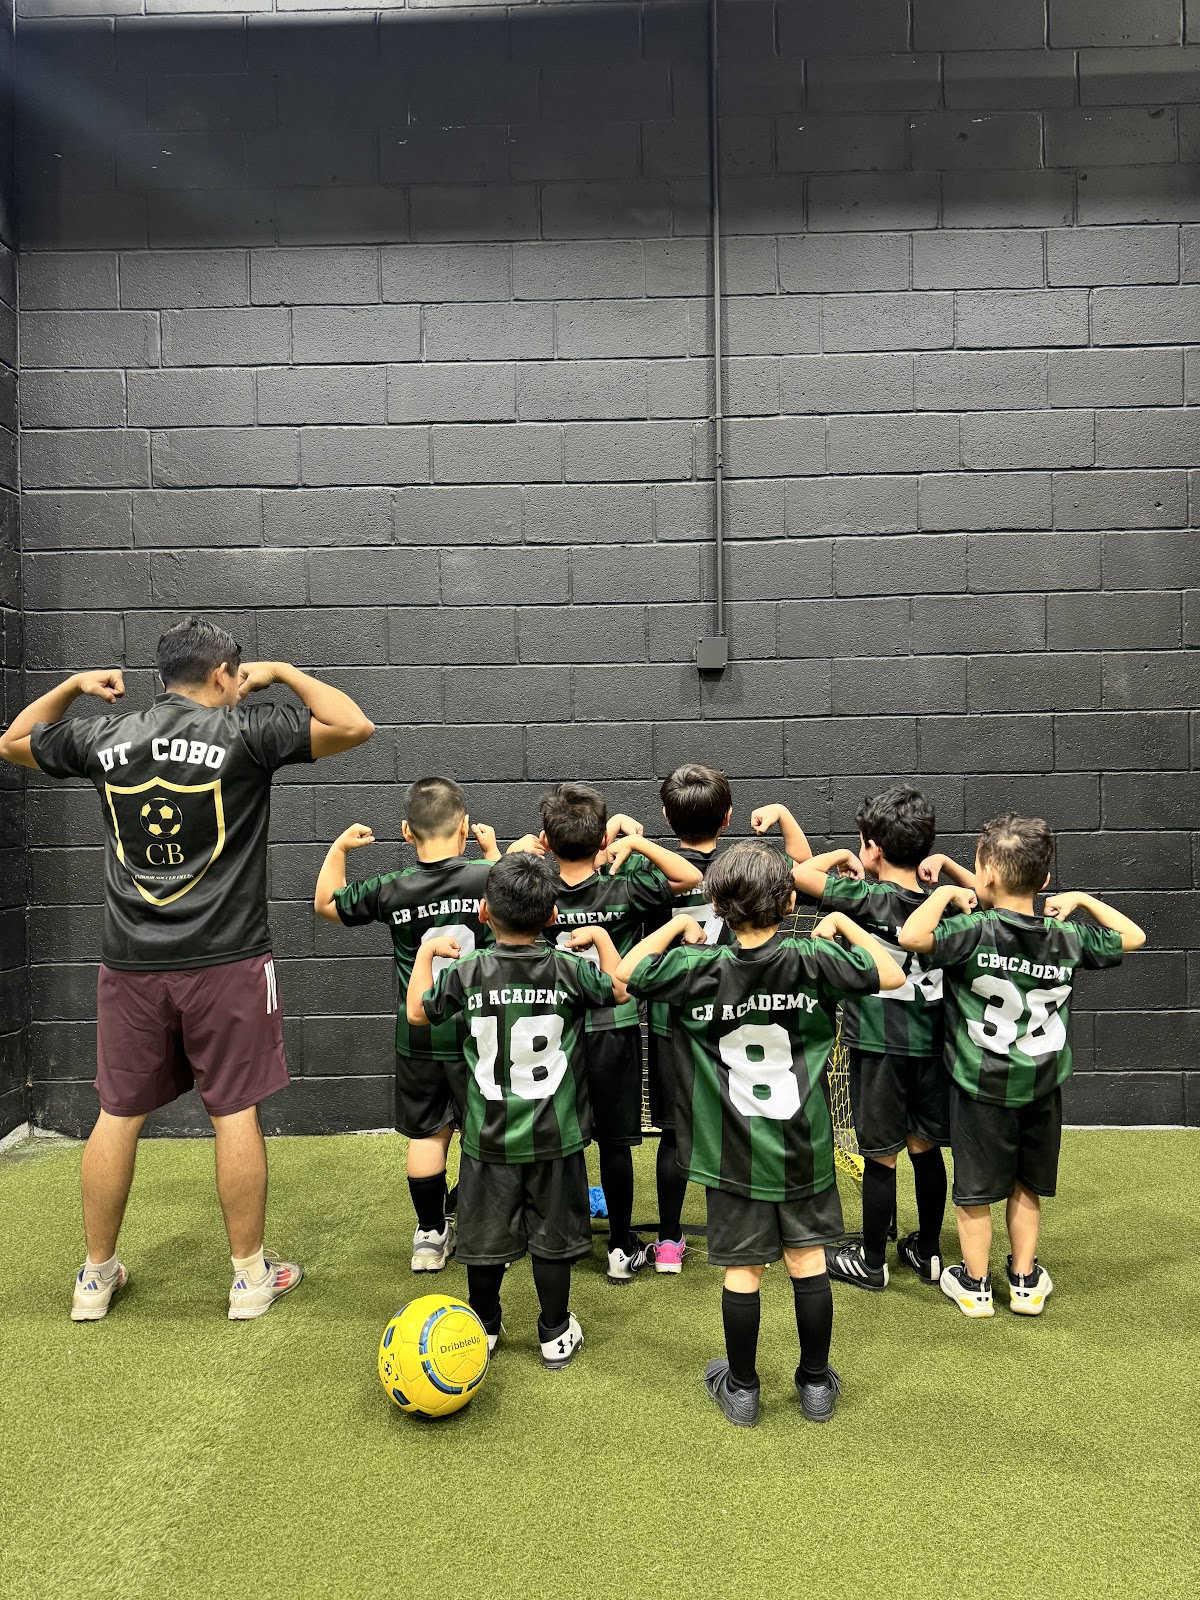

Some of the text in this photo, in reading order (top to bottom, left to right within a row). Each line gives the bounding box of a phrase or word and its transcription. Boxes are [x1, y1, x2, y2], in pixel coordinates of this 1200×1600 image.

[151, 738, 226, 769] COBO
[145, 843, 185, 865] CB
[392, 909, 411, 925] CB
[555, 912, 625, 925] CADEMY
[977, 953, 1072, 981] CB ACADEMY
[467, 993, 483, 1011] CB
[692, 993, 818, 1020] CB ACADEMY
[471, 1014, 568, 1100] 18
[719, 1023, 801, 1120] 8
[440, 1336, 481, 1353] DribbleUp
